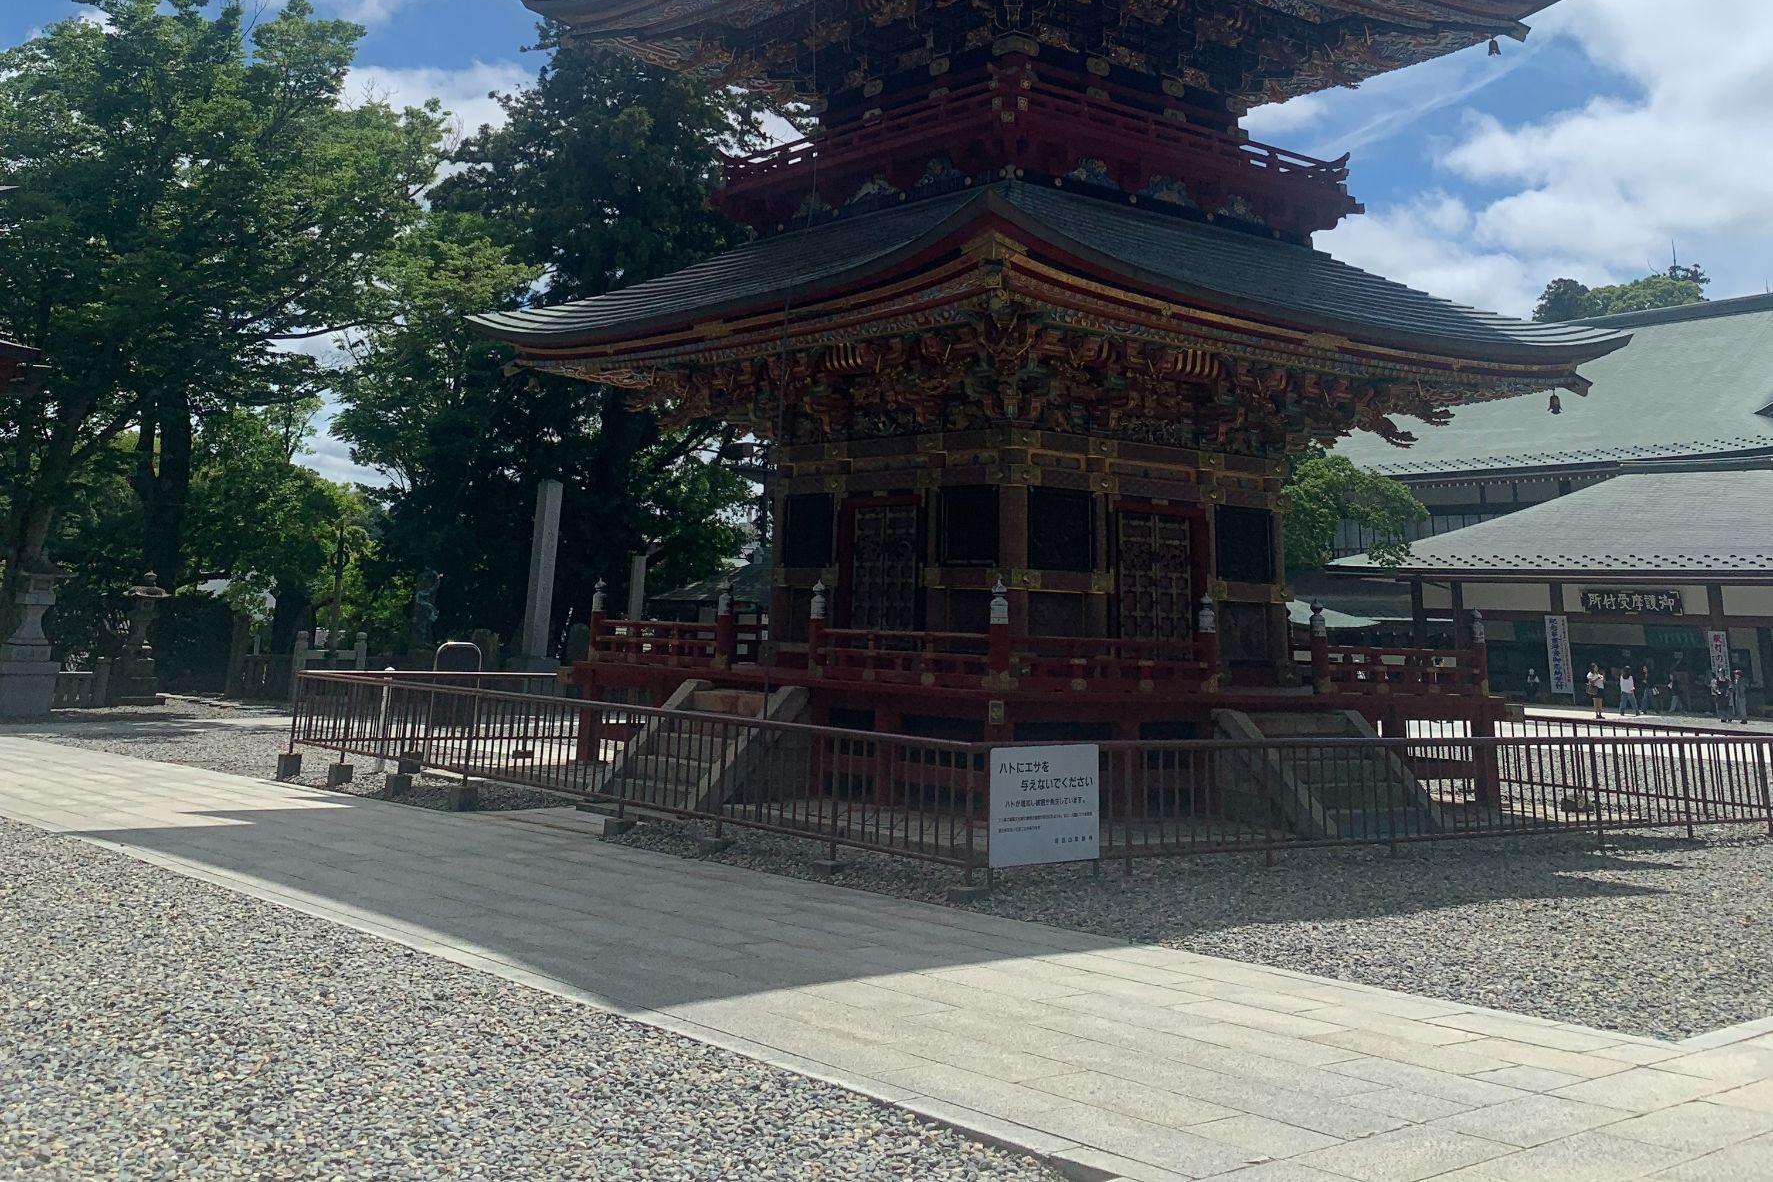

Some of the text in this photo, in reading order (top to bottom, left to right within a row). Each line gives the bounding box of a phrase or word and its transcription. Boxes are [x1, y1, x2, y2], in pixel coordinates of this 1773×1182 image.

[999, 761, 1050, 774] ハトにエサを
[1020, 776, 1093, 792] 与えないでください
